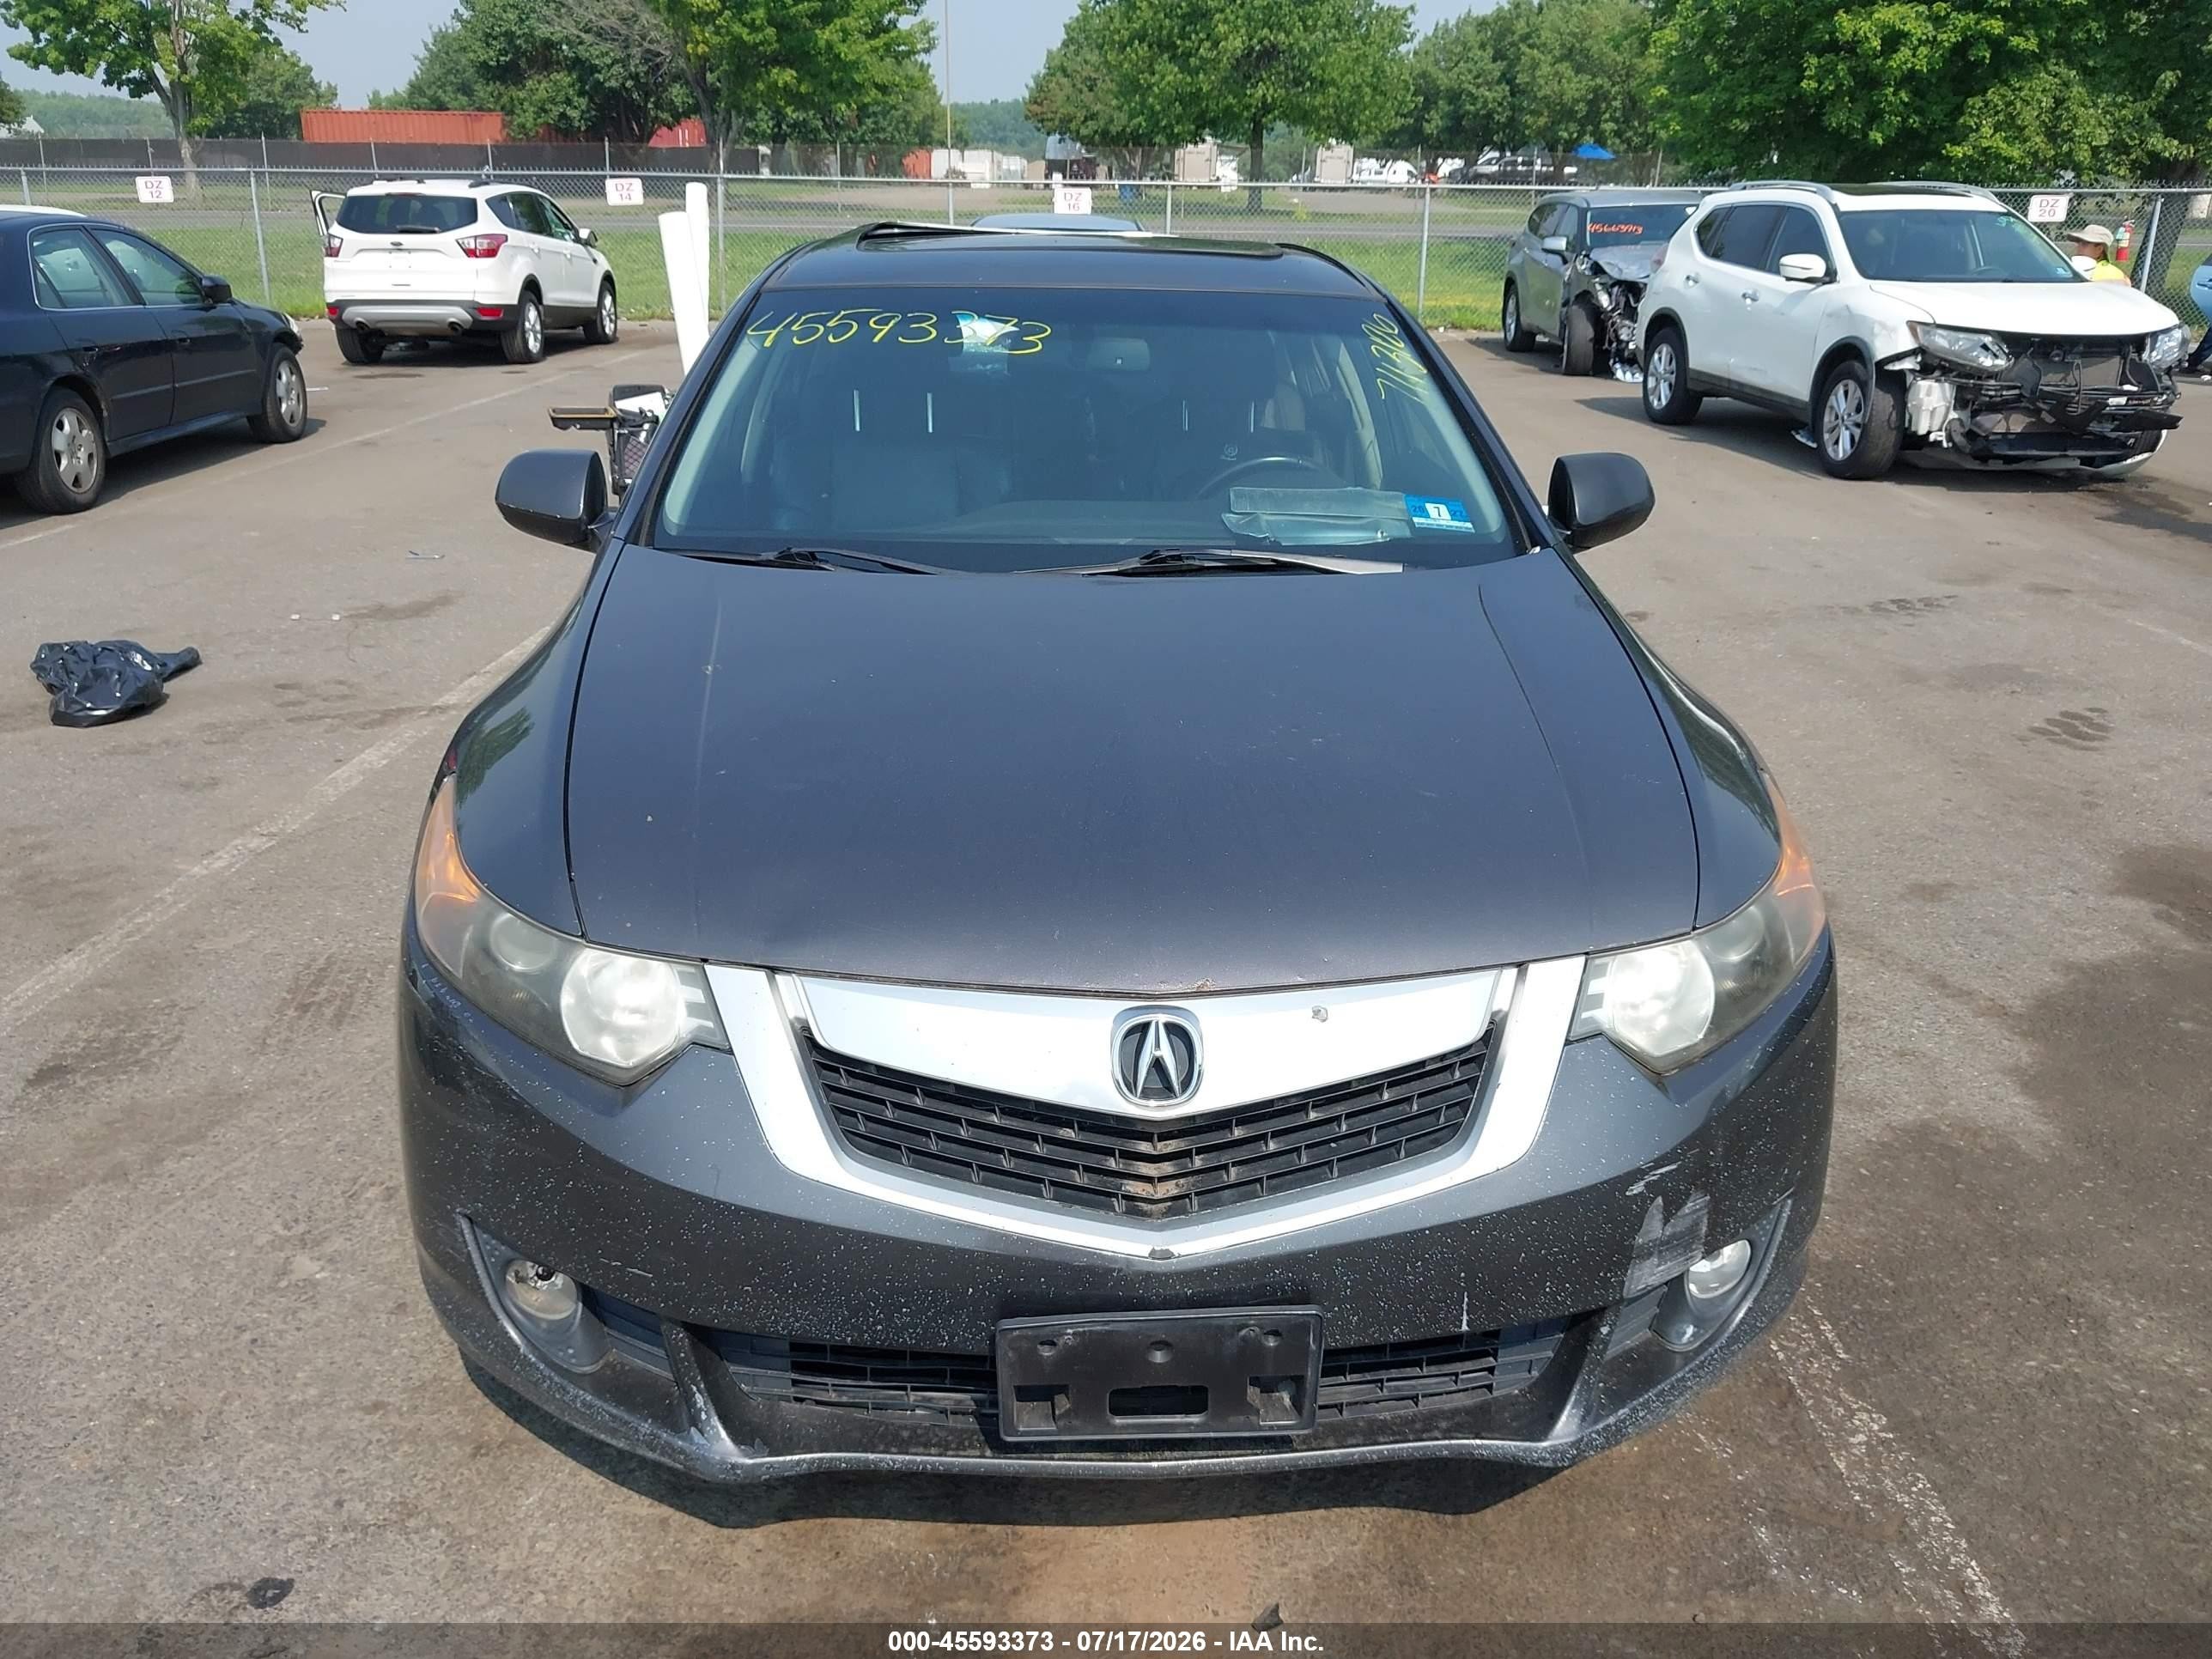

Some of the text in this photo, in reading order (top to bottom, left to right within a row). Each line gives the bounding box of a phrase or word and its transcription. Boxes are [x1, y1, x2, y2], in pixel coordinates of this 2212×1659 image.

[144, 180, 163, 190] DZ
[615, 182, 635, 191] DZ
[149, 190, 163, 199] 12
[619, 192, 632, 202] 14
[1064, 192, 1082, 202] DZ
[1067, 203, 1080, 212] 16
[2039, 198, 2060, 208] DZ
[2039, 208, 2057, 217] 20
[746, 308, 1052, 355] 45593373
[1432, 506, 1442, 518] 7
